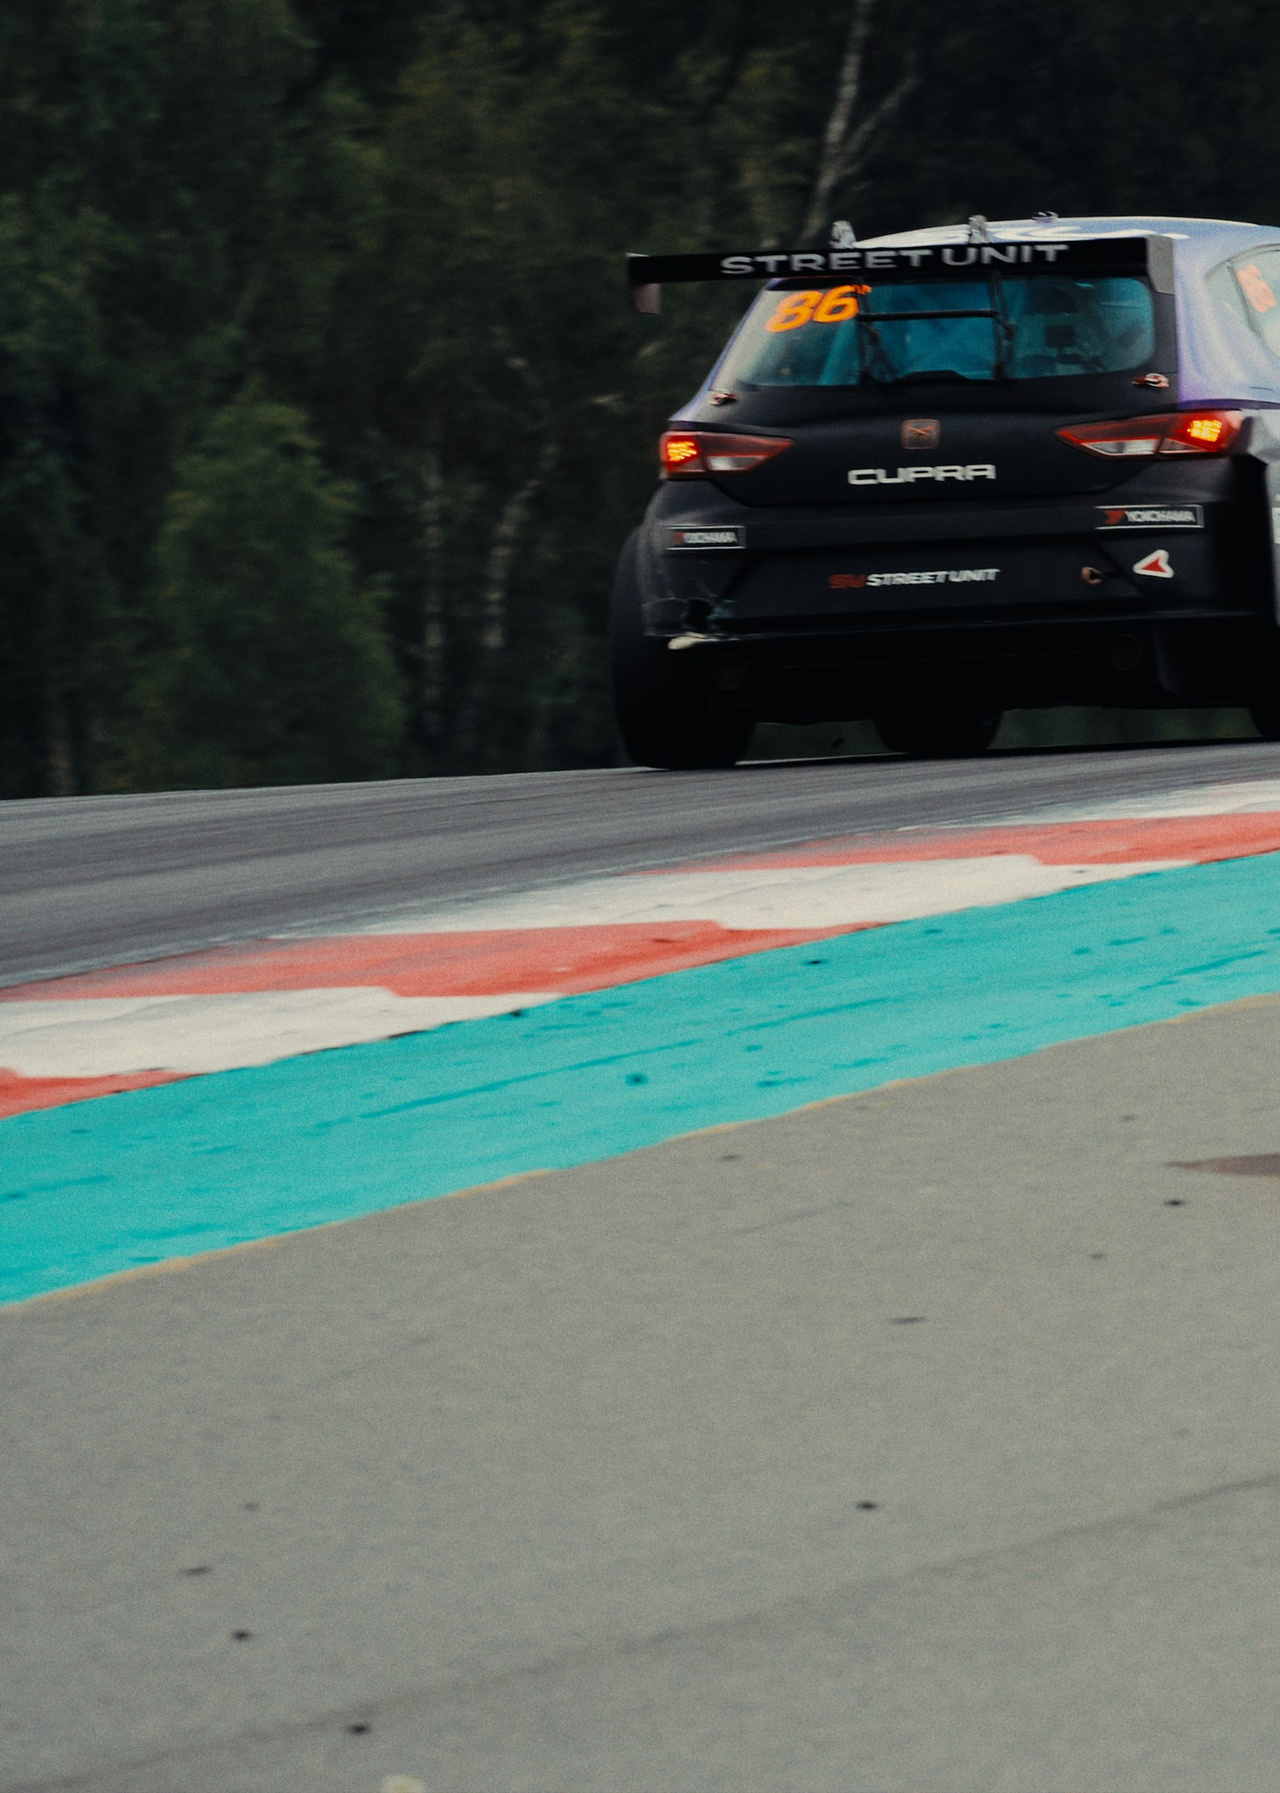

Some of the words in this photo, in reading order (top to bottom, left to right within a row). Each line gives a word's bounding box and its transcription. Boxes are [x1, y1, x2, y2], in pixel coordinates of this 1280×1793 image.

[720, 250, 932, 274] STREET
[942, 244, 1069, 266] UNIT
[765, 285, 859, 332] 86
[848, 464, 996, 485] CUPRA
[866, 570, 949, 586] STREET
[949, 568, 1000, 582] UNIT
